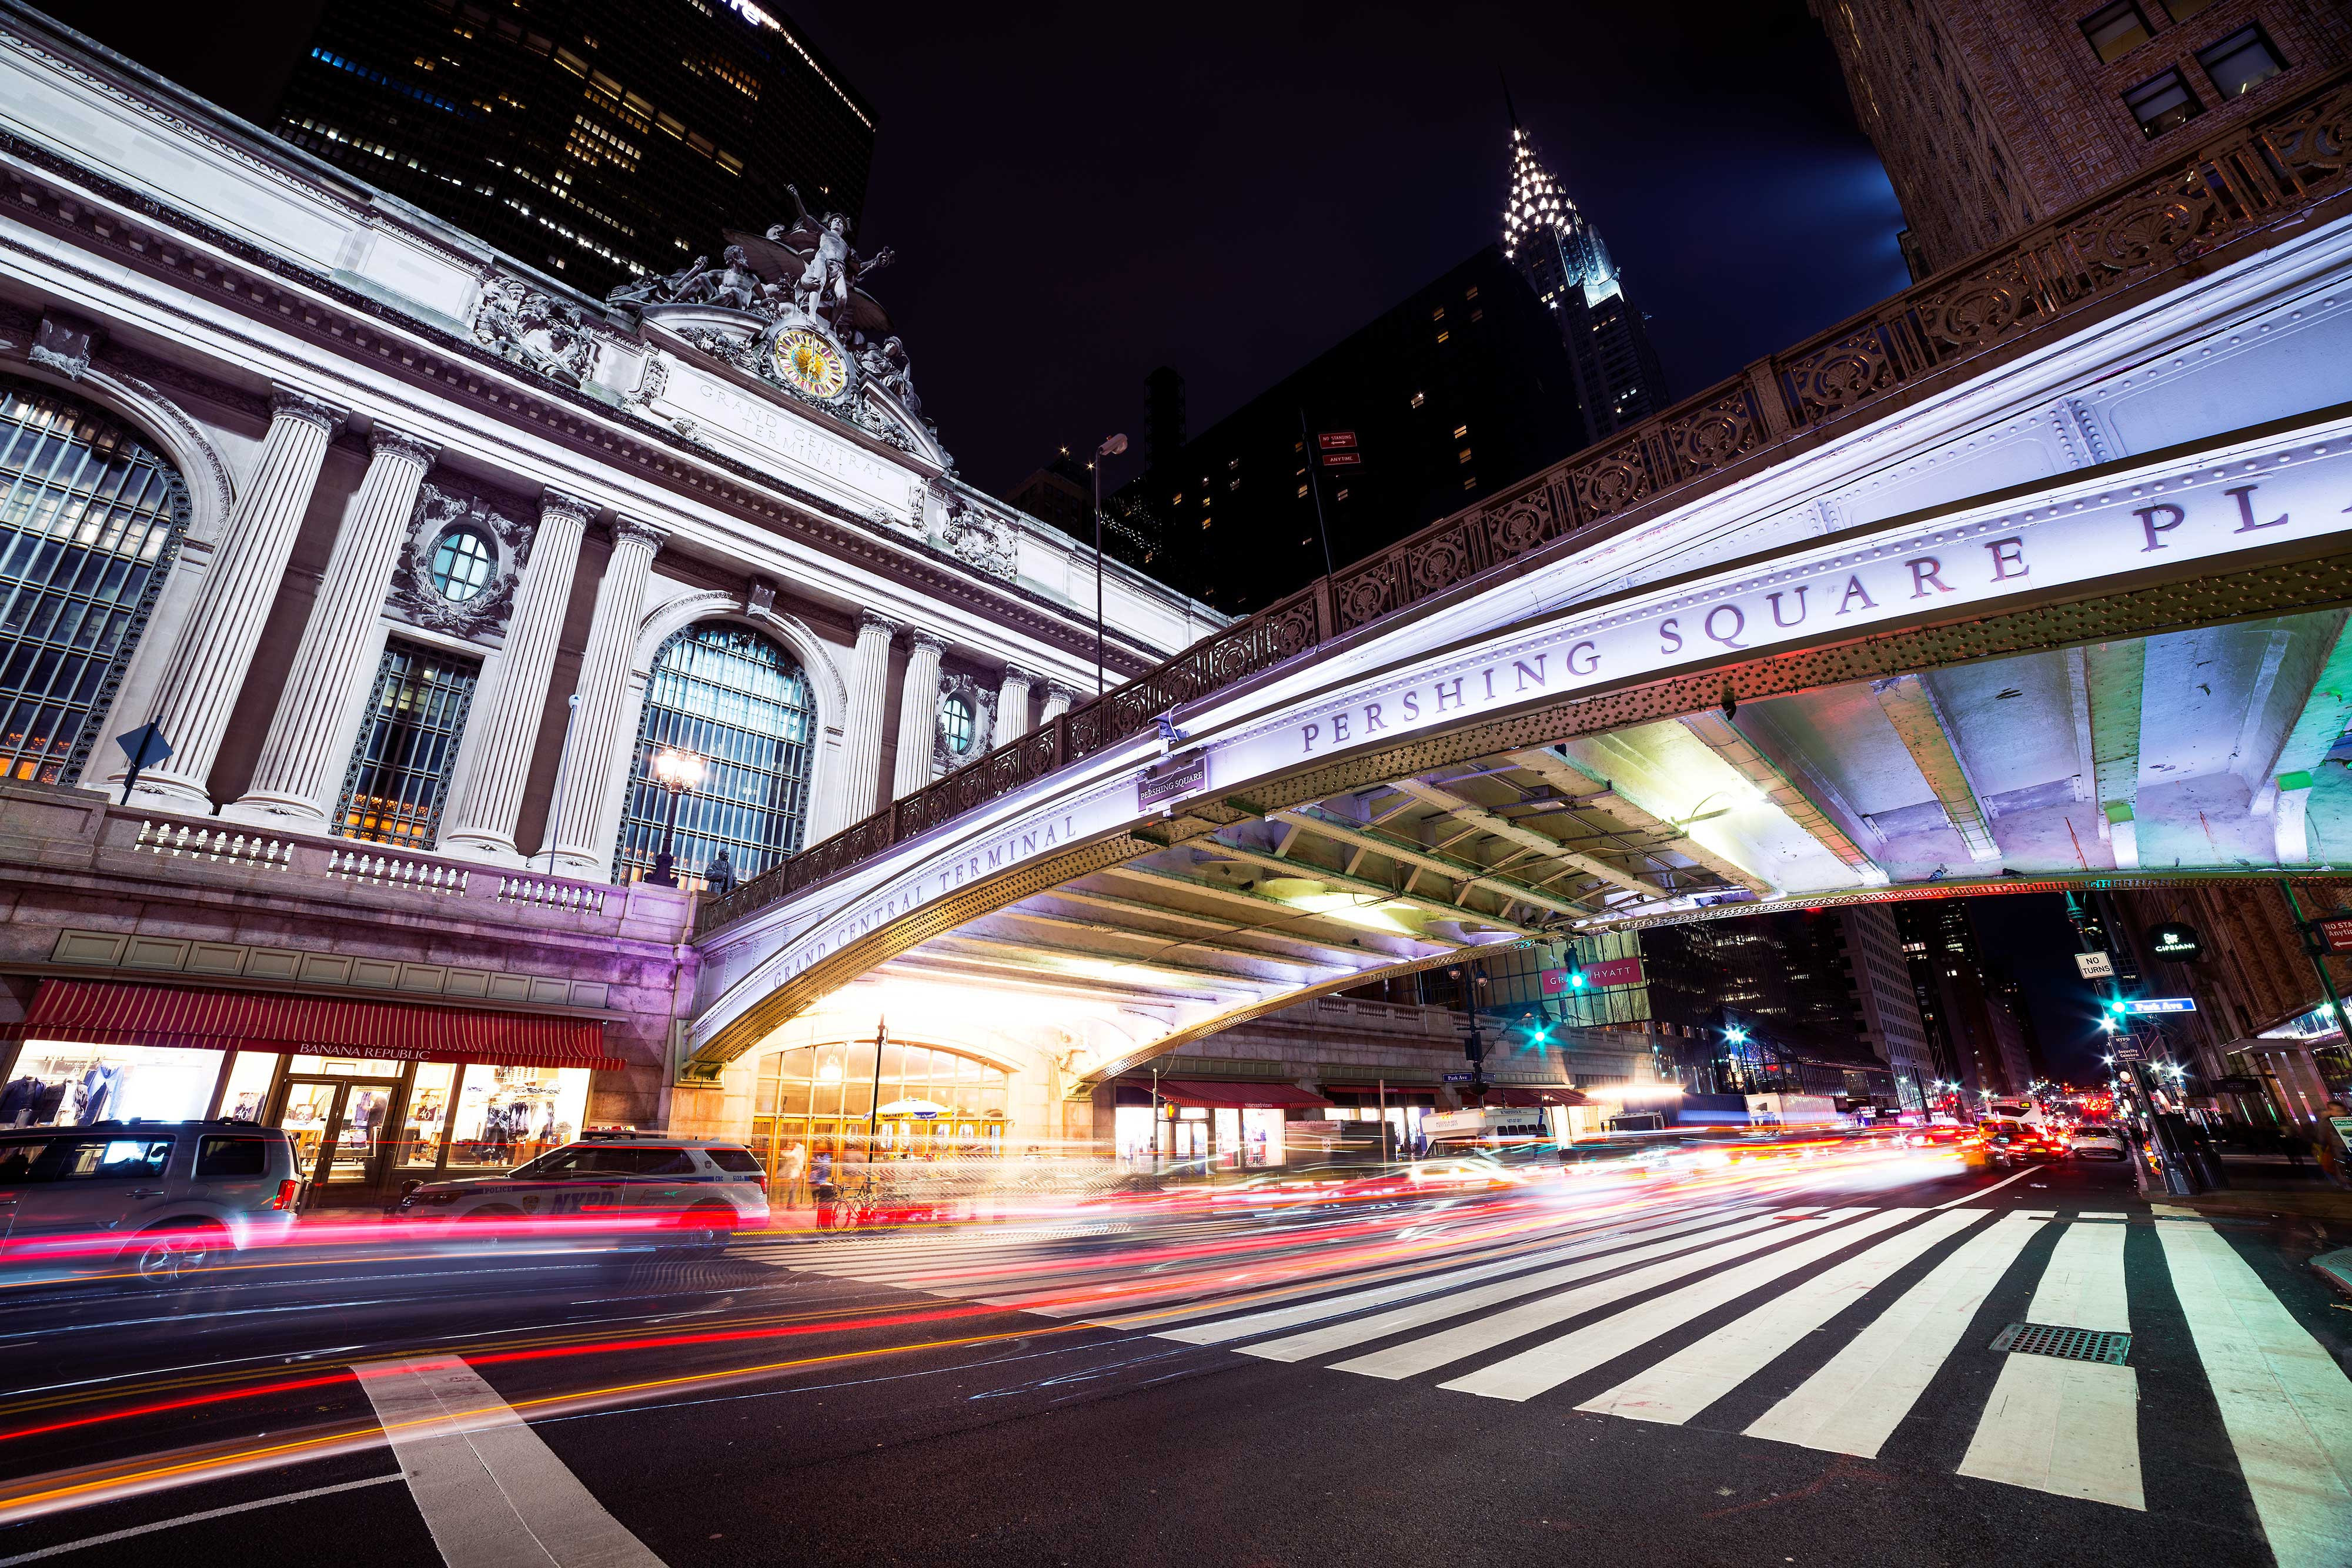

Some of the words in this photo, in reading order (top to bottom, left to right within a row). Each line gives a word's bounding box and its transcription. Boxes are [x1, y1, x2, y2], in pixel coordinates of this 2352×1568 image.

[700, 385, 777, 428] GRAND
[794, 429, 884, 480] CENTRAL
[742, 417, 846, 476] TERMINAL
[1301, 640, 1602, 753] PERSHING
[1659, 536, 2030, 655] SQUARE
[2132, 484, 2352, 553] PL
[1140, 782, 1174, 800] PERSHING
[1175, 771, 1203, 788] SQUARE
[773, 943, 826, 989] GRAND
[837, 885, 924, 947] CENTRAL
[938, 815, 1076, 892] TERMINAL
[2155, 943, 2196, 952] CIPRIANI
[2082, 965, 2111, 974] TURNS
[2086, 957, 2099, 965] NO
[1550, 974, 1587, 985] GRD
[1593, 967, 1631, 979] HYATT
[2134, 1002, 2161, 1011] Park
[2162, 1002, 2183, 1010] Ave
[300, 1044, 360, 1057] BANANA
[364, 1047, 430, 1060] REPUBLIC
[484, 1185, 512, 1194] POLICE
[549, 1191, 614, 1215] NYPD
